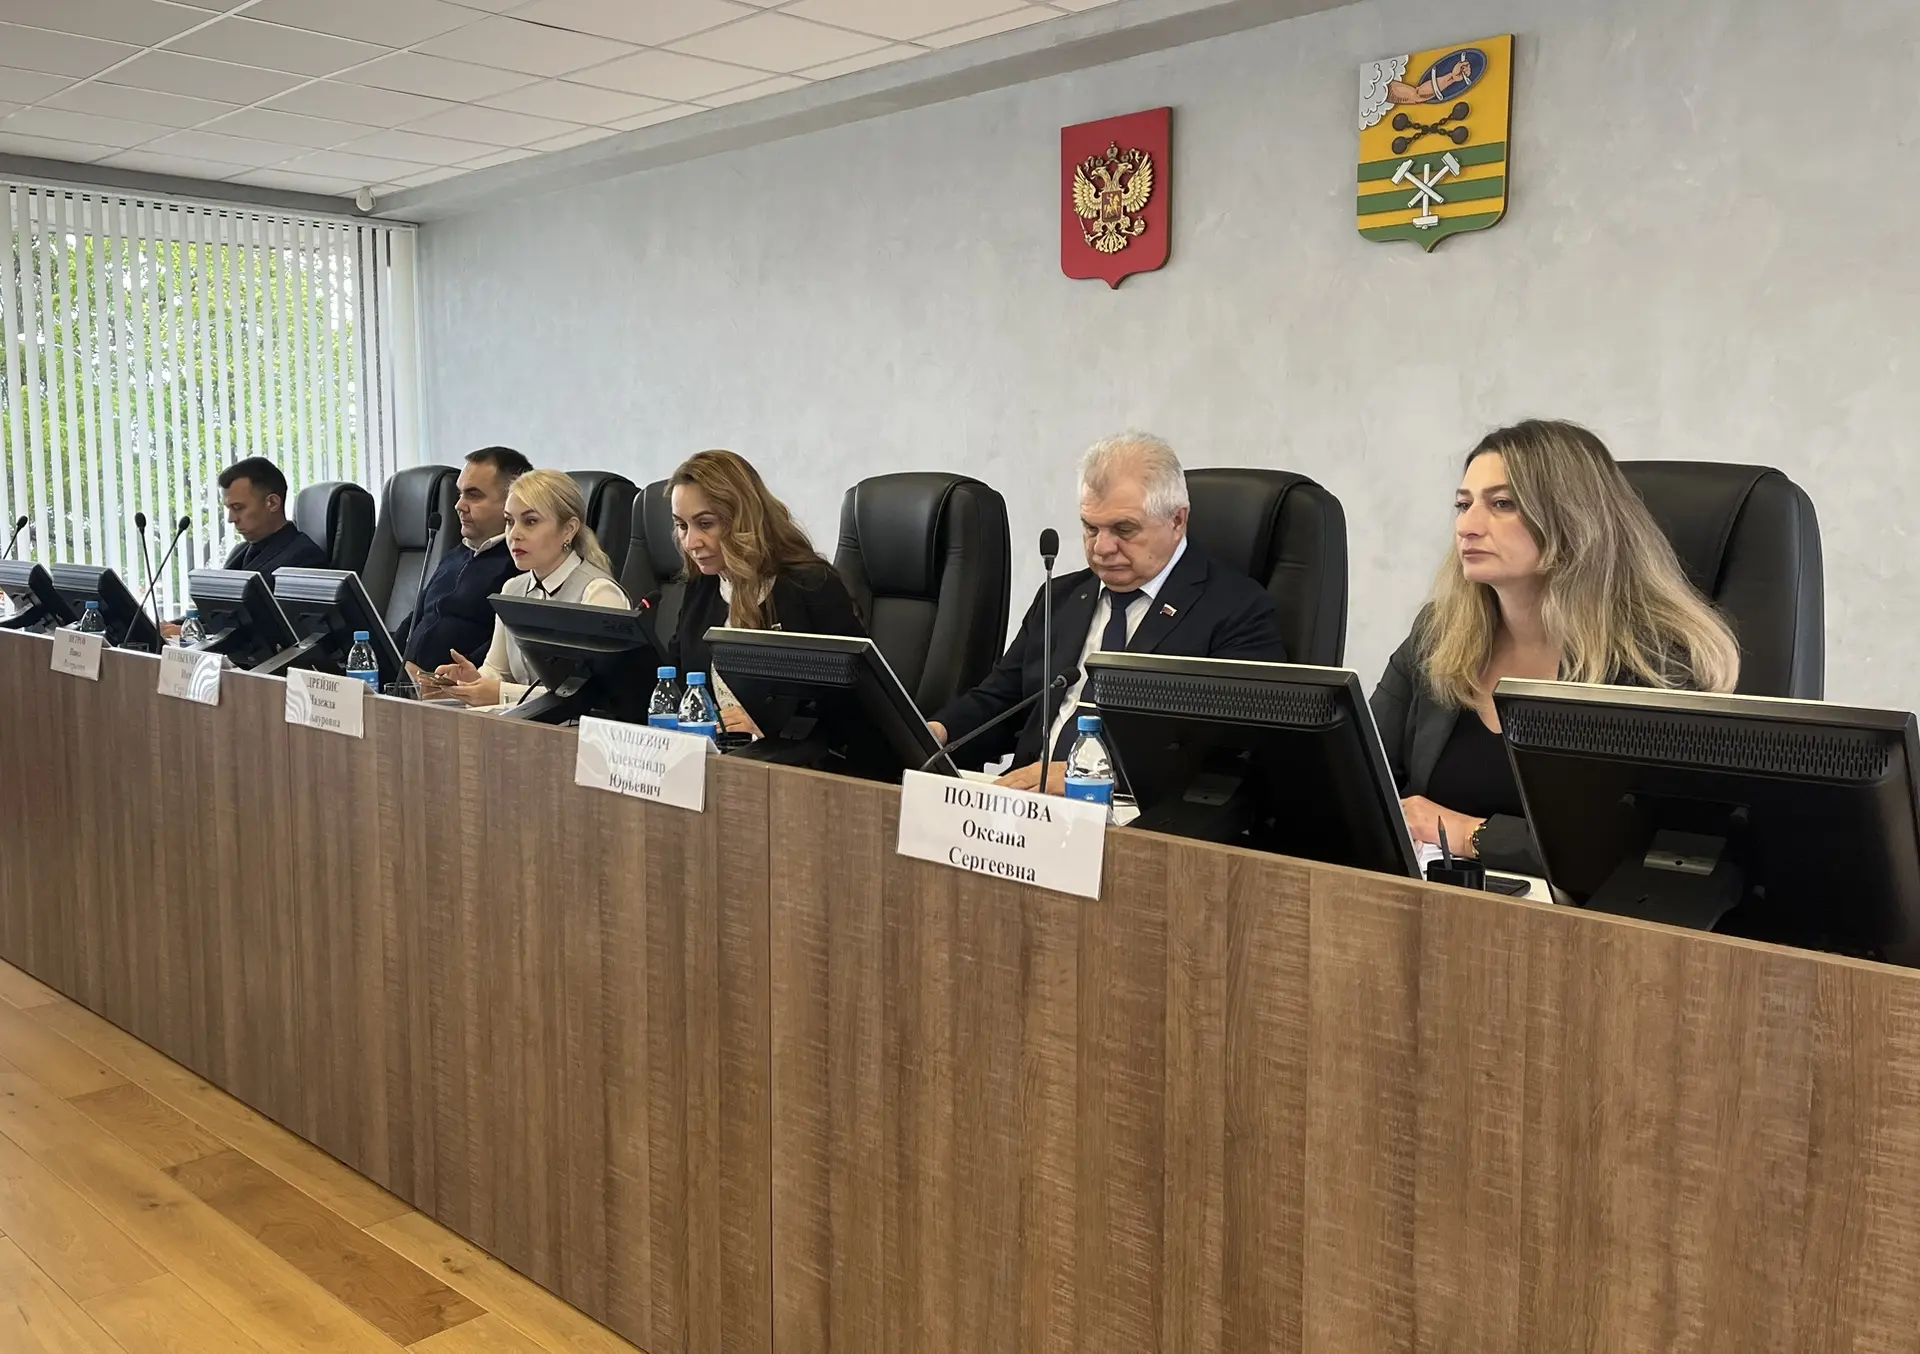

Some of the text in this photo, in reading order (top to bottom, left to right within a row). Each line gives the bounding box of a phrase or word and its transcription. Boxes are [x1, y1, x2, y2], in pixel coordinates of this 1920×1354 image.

[609, 773, 661, 797] Юрьевич
[944, 786, 1052, 823] ПОЛИТОВА
[962, 819, 1026, 849] Оксана
[949, 846, 1036, 882] Сергеевна
